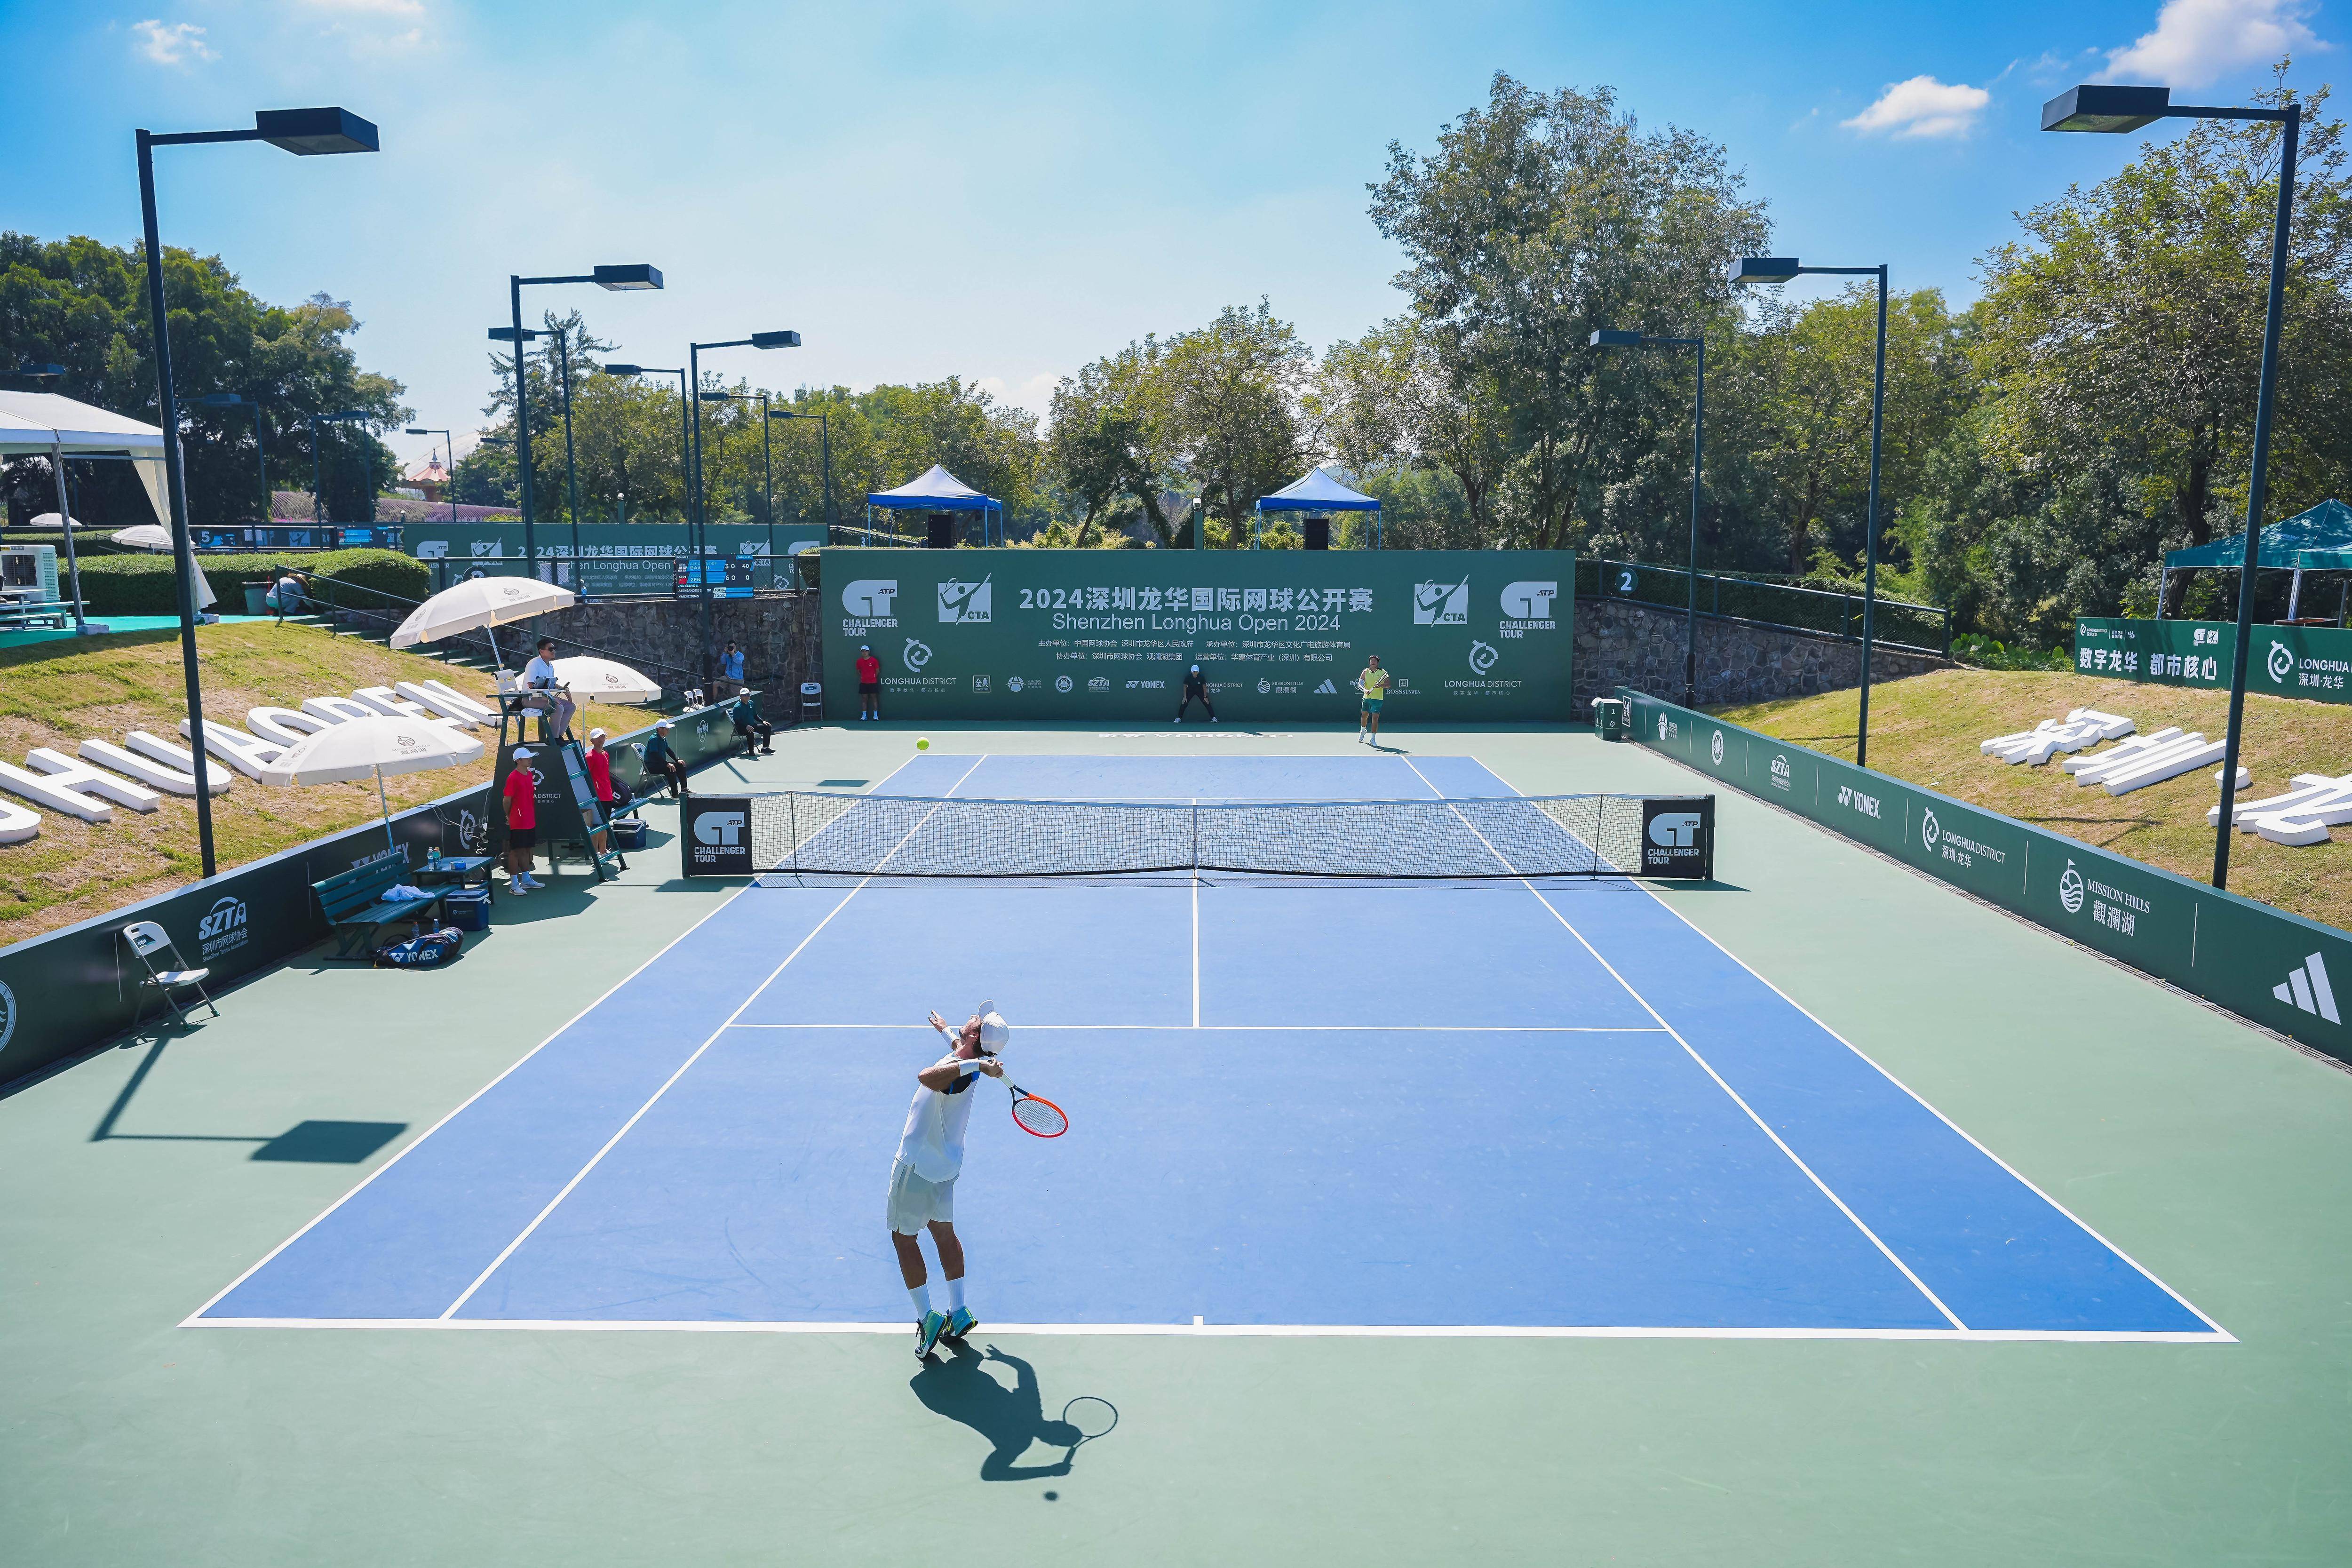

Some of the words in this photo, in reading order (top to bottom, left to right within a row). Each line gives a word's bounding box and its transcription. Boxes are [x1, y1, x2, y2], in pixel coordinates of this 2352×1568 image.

[201, 531, 210, 543] 5
[594, 561, 638, 572] Longhua
[642, 560, 670, 571] Open
[1621, 572, 1632, 591] 2
[1019, 587, 1373, 612] 2024深圳龙华国际网球公开赛
[967, 611, 990, 620] CTA
[1053, 613, 1145, 629] Shenzhen
[1152, 613, 1232, 634] Longhua
[1238, 614, 1288, 634] Open
[1295, 614, 1341, 630] 2024
[1443, 613, 1465, 621] CTA
[1499, 621, 1556, 629] CHALLENGER
[2080, 648, 2137, 673] 数字龙华
[2150, 653, 2217, 680] 都市核心
[2299, 658, 2349, 673] LONGHUA
[2298, 673, 2344, 690] 深圳·龙华
[1771, 759, 1790, 778] SZTA
[1854, 790, 1880, 819] YONEX
[1942, 844, 1971, 868] 深圳·龙华
[1943, 829, 1975, 852] LONGHUA
[1975, 843, 2005, 864] DISTRICT
[2087, 878, 2123, 902] MISSION
[2124, 893, 2150, 914] HILLS
[199, 902, 247, 940] SZTA
[202, 927, 248, 955] 深圳市网球协会
[406, 948, 438, 962] YONEX
